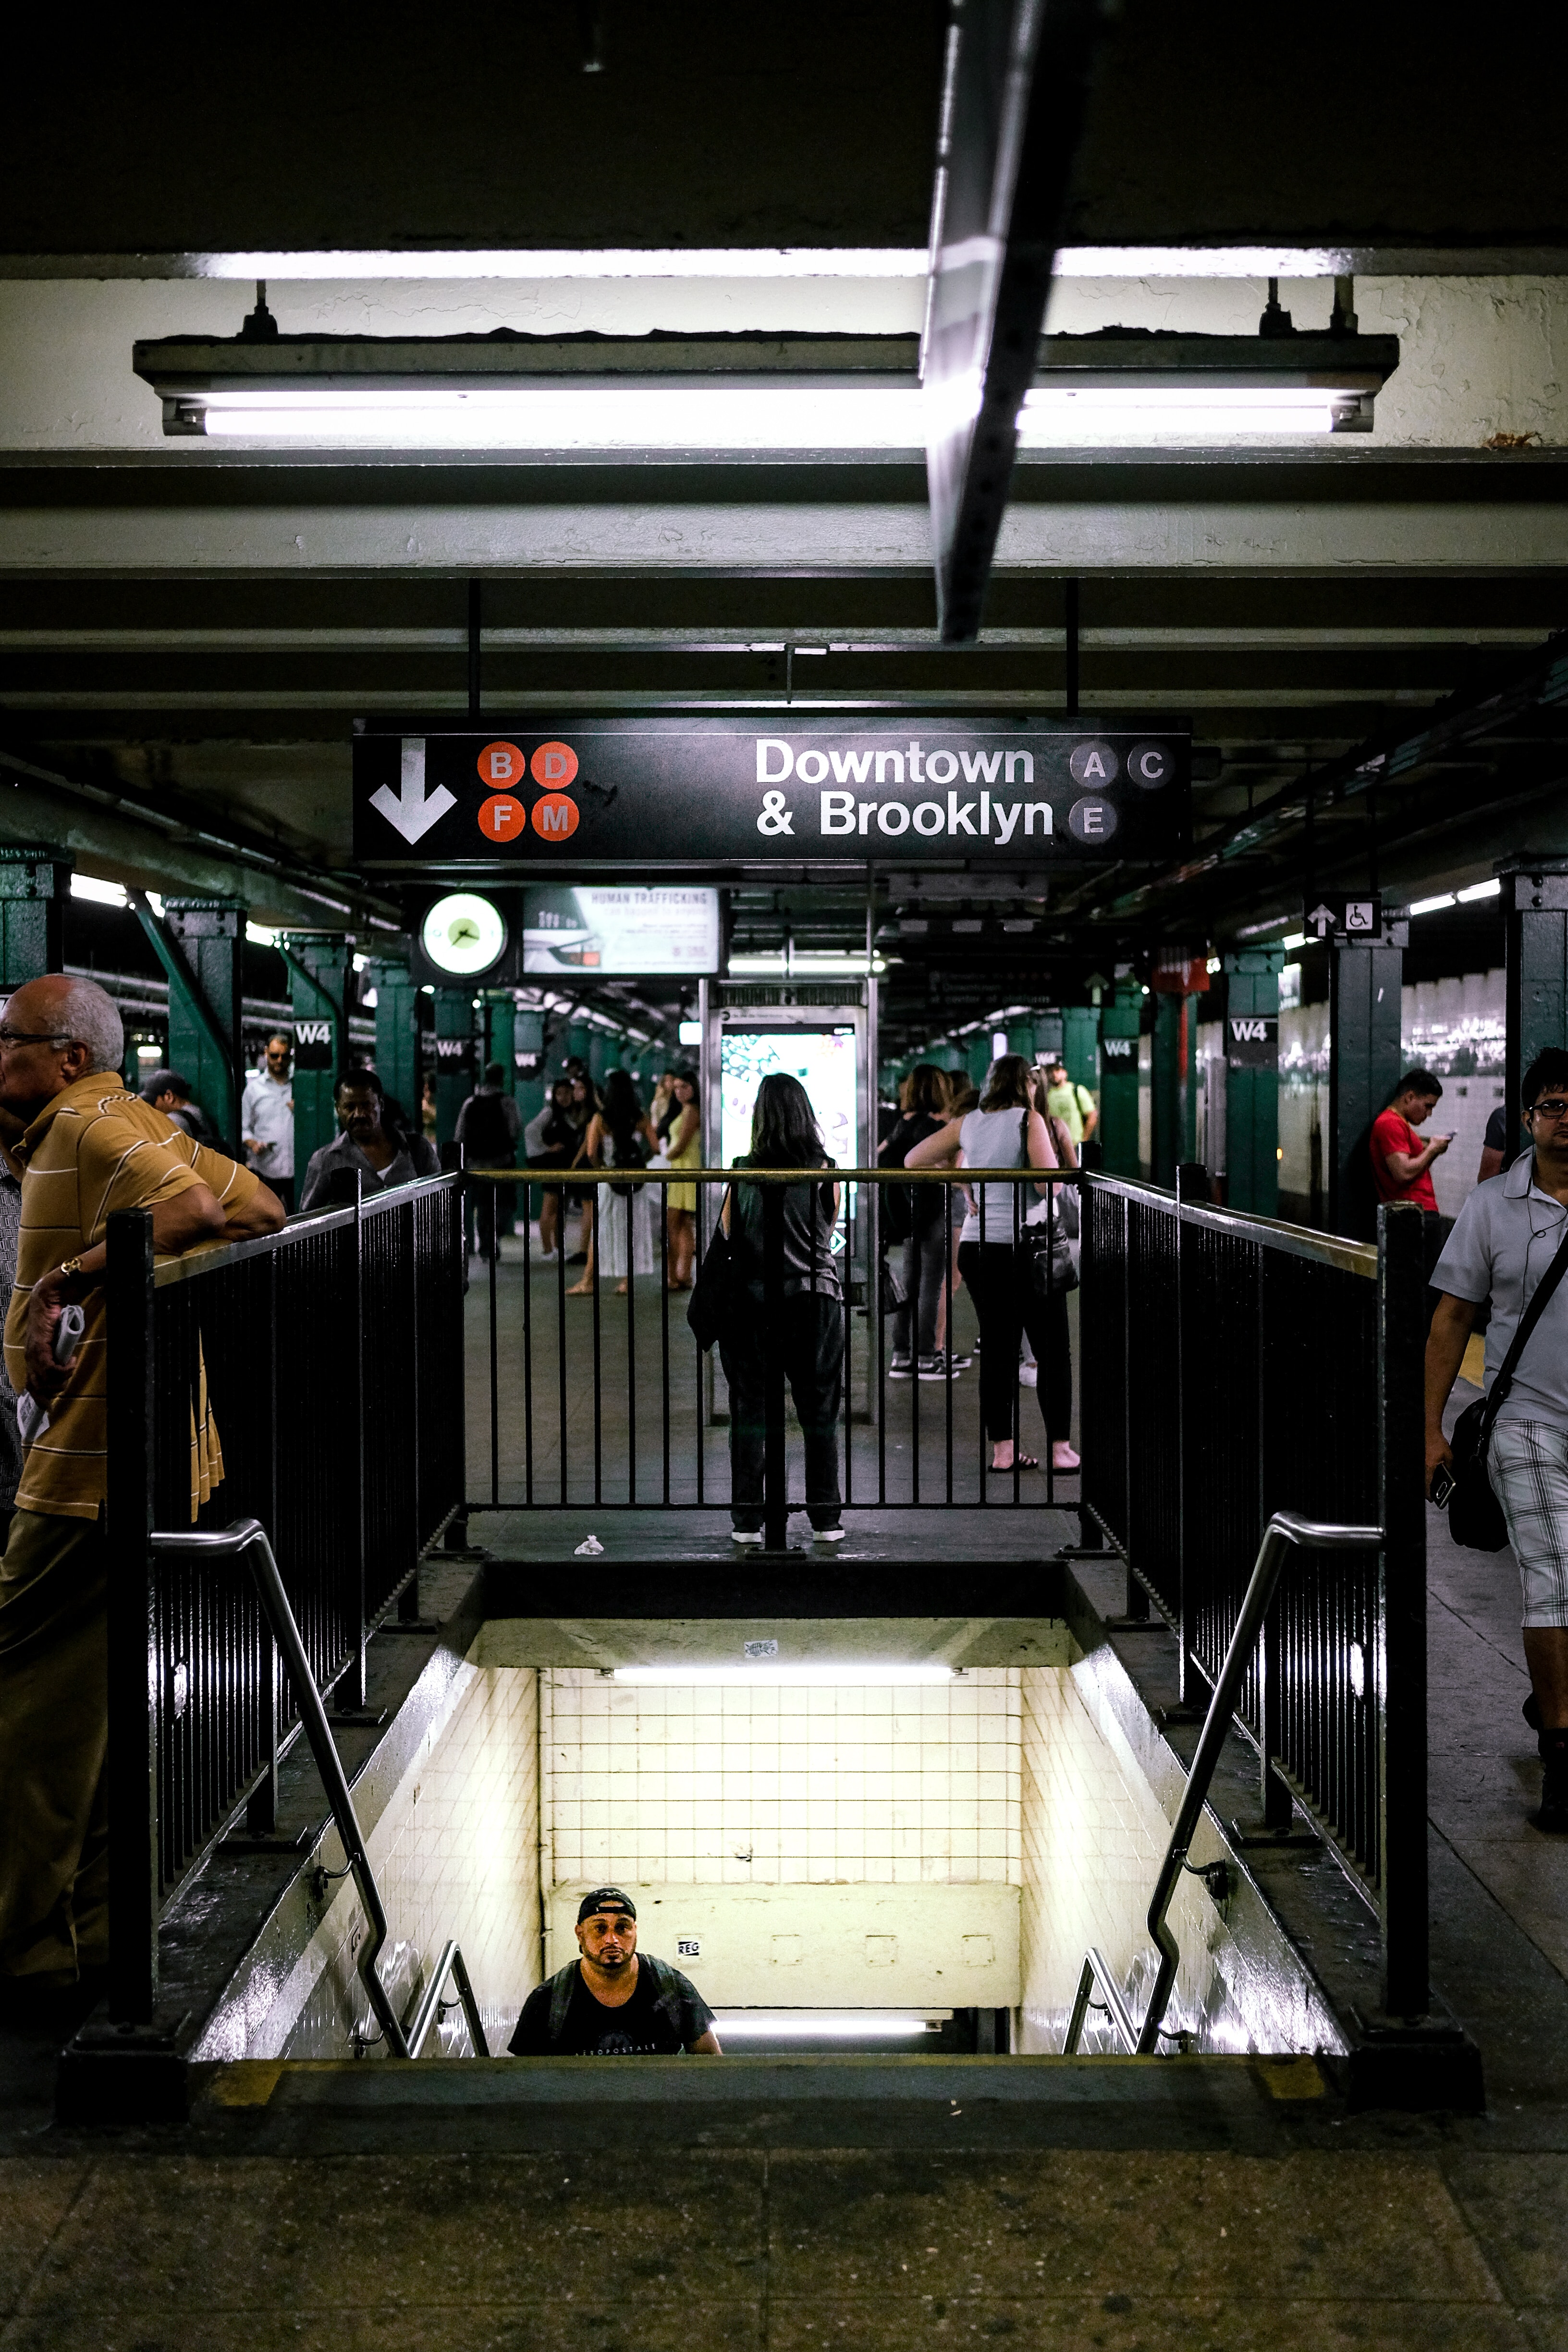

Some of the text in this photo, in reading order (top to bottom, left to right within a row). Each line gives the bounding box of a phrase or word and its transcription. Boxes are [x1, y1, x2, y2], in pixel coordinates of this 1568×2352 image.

[490, 752, 567, 779] B D
[756, 738, 1034, 784] Downtown
[1084, 751, 1164, 779] A C
[494, 805, 568, 831] F M
[756, 790, 1054, 845] & Brooklyn
[1084, 807, 1104, 833] E
[591, 892, 707, 905] HUMAN TRAFFICKING
[295, 1024, 331, 1045] W4
[1231, 1020, 1268, 1041] W4
[437, 1040, 463, 1057] W4
[1104, 1041, 1131, 1057] W4
[678, 1942, 699, 1954] REG
